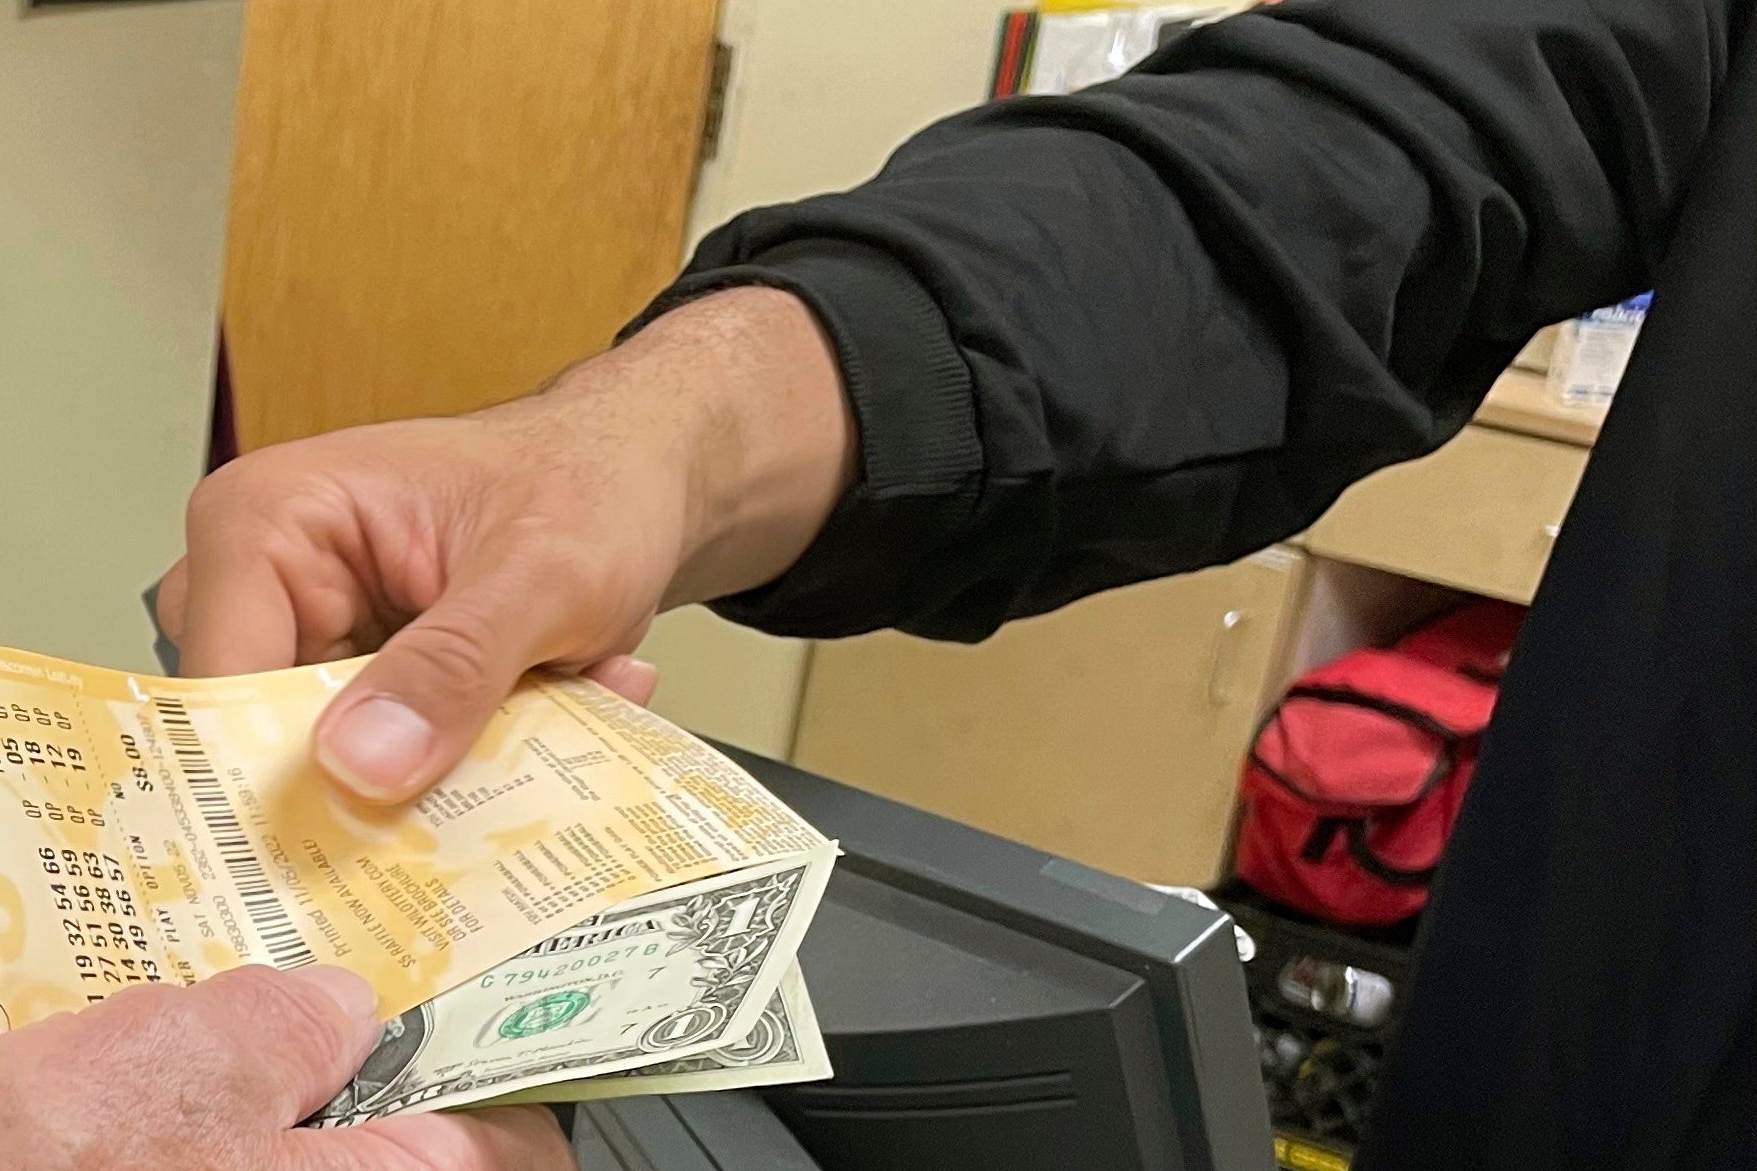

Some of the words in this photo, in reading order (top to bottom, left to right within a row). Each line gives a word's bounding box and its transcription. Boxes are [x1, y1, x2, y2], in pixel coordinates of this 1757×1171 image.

[1, 738, 24, 765] 05
[24, 741, 46, 767] 18
[46, 743, 67, 770] 12
[68, 748, 87, 772] 19
[121, 734, 154, 792] $8.00
[39, 847, 61, 874] 66
[62, 849, 83, 876] 59
[83, 852, 104, 879] 63
[104, 855, 125, 882] 57
[129, 835, 158, 890] OPTION
[56, 883, 74, 910] 54
[78, 885, 95, 912] 56
[385, 861, 438, 913] BROCHURE
[425, 876, 467, 915] DETAILS
[100, 888, 117, 914] 38
[120, 890, 137, 917] 56
[344, 895, 376, 925] NOW
[157, 908, 181, 944] PLAY
[194, 913, 215, 939] SAT
[428, 906, 455, 929] SEE
[457, 910, 484, 934] FOR
[68, 919, 86, 947] 32
[91, 923, 108, 947] 51
[112, 923, 130, 950] 30
[131, 926, 149, 952] 49
[308, 908, 353, 958] Printed
[365, 921, 406, 958] RAFFLE
[419, 924, 451, 952] VISIT
[444, 923, 466, 943] OR
[76, 955, 96, 982] 19
[102, 956, 121, 984] 27
[125, 958, 142, 982] 14
[504, 945, 635, 986] 79420027
[643, 943, 659, 957] B
